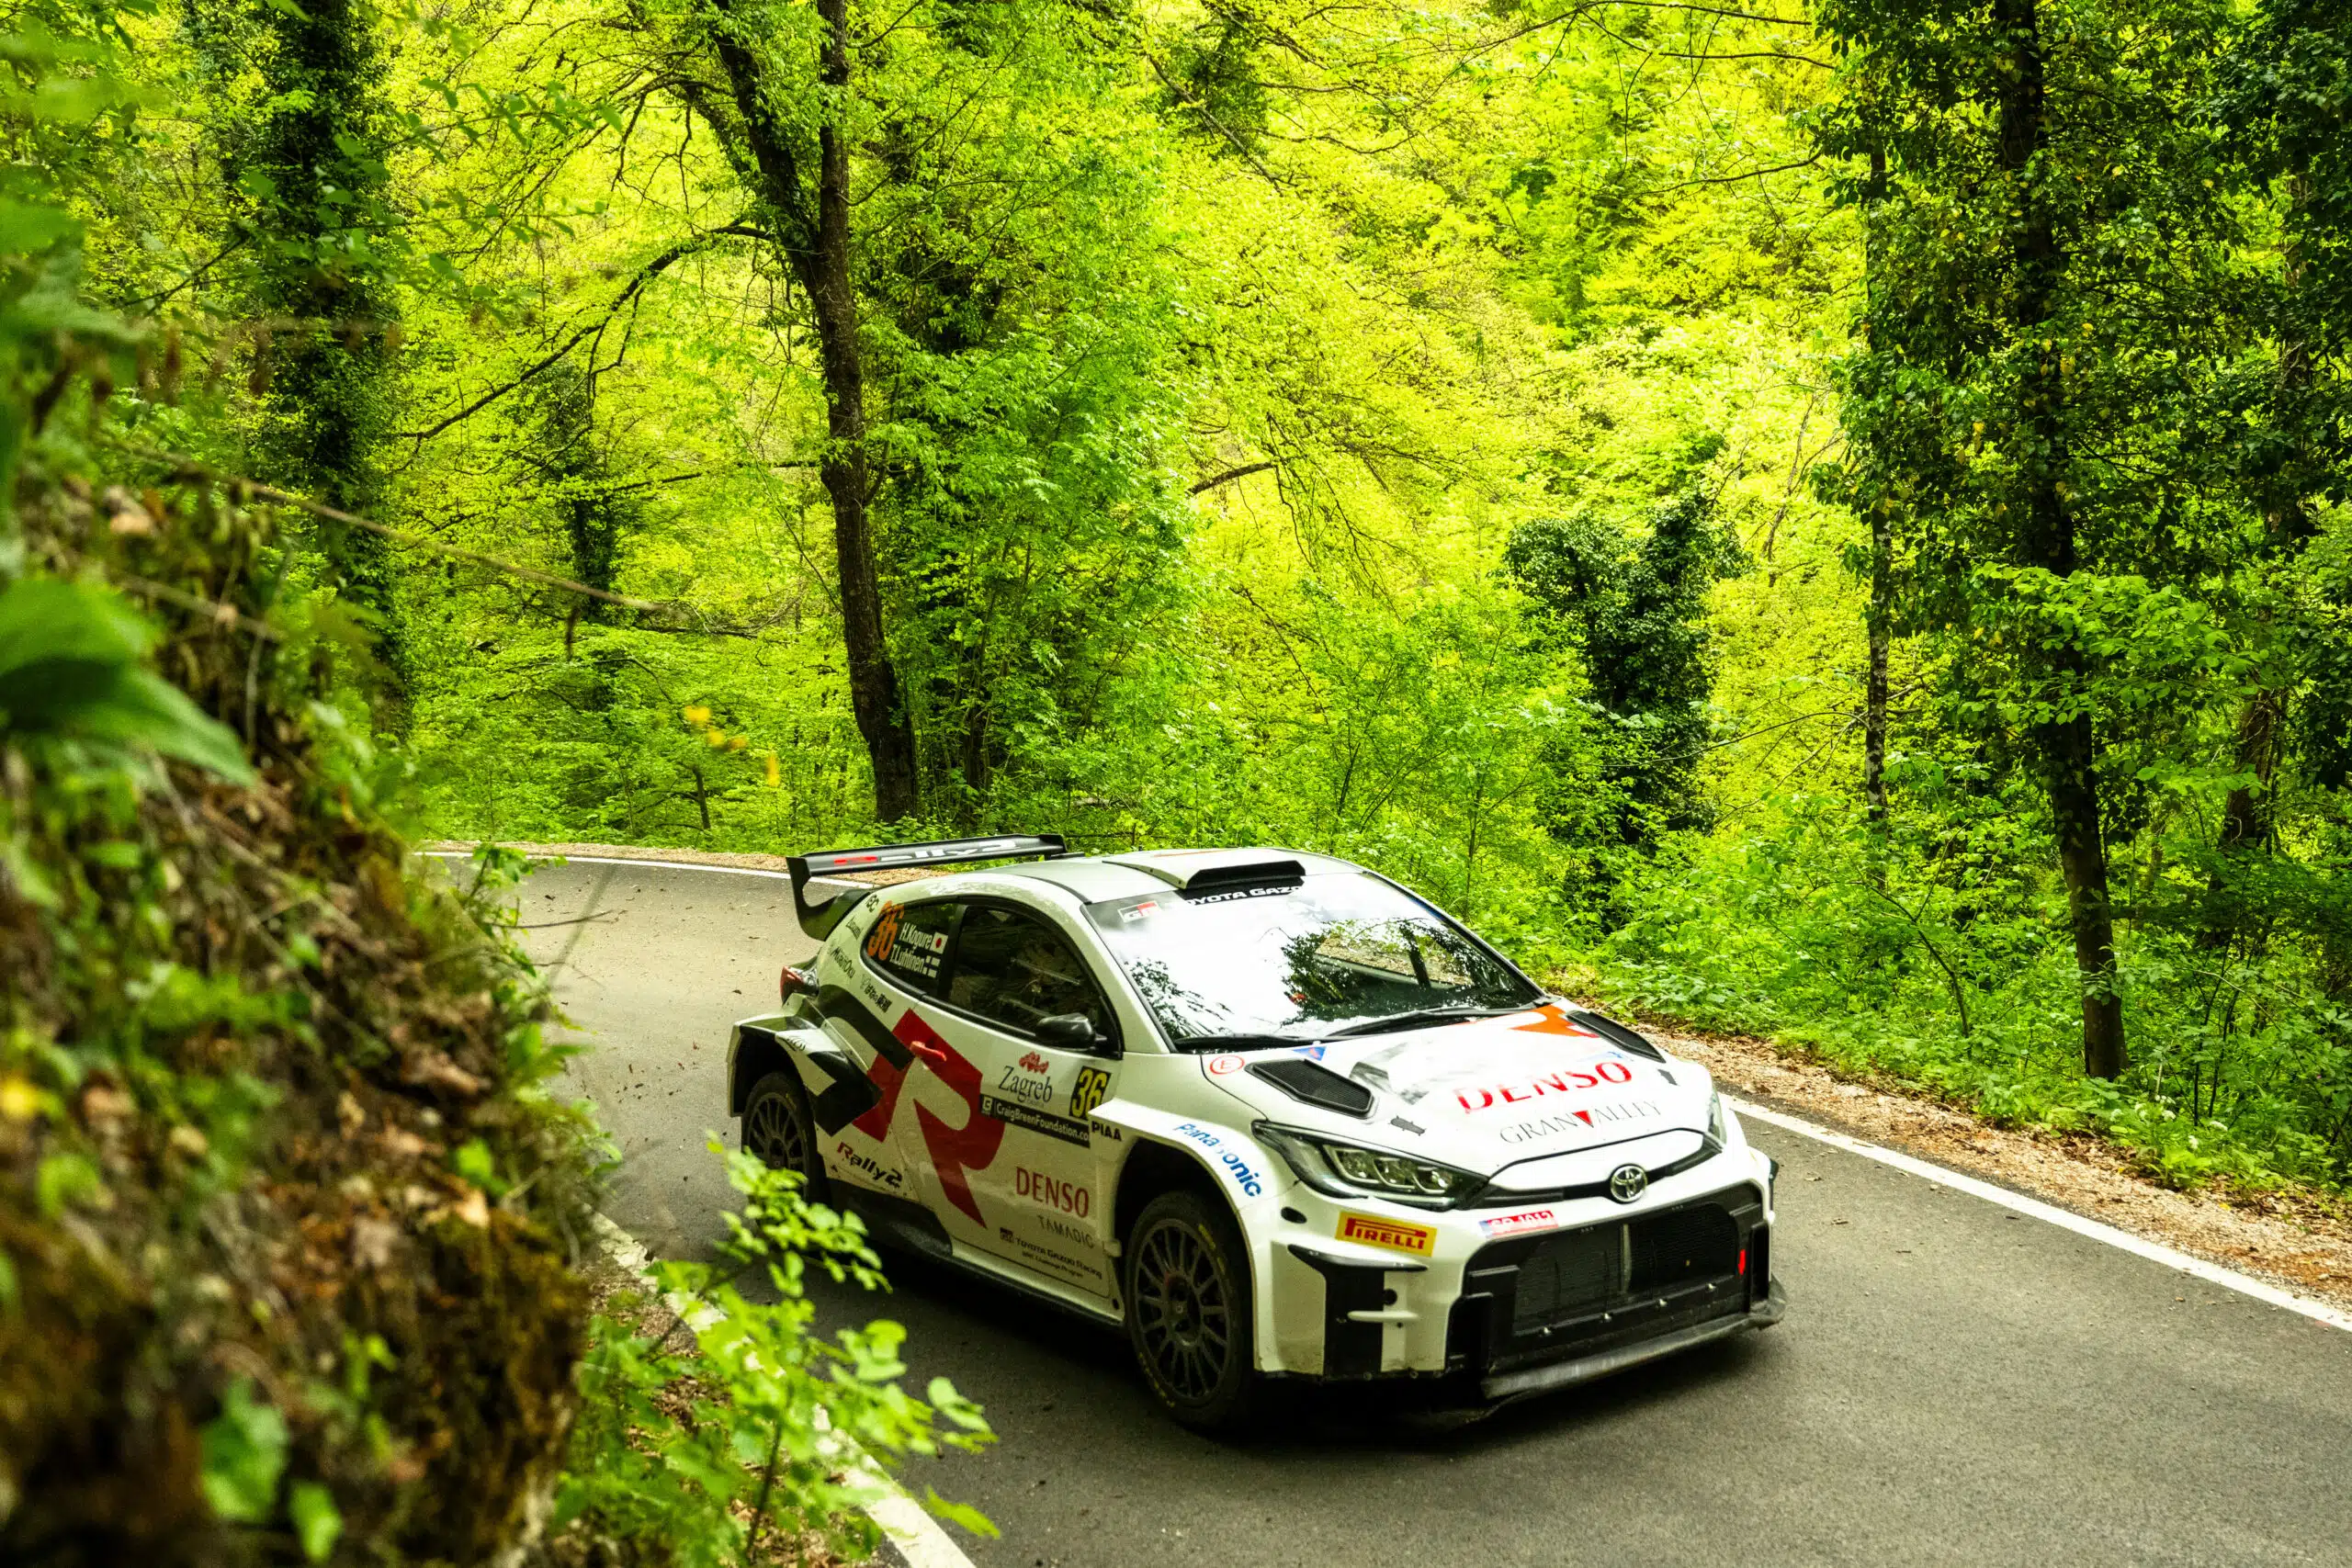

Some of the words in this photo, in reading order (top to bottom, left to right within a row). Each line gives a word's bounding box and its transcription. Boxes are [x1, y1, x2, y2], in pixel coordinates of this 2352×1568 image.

[1188, 889, 1247, 906] OYOTA
[866, 899, 905, 961] 36
[998, 1065, 1053, 1103] Zagreb
[1071, 1068, 1108, 1118] 36
[1453, 1062, 1632, 1114] DENSO
[996, 1102, 1089, 1142] CraigBreenFoundation.co
[1091, 1121, 1123, 1142] PIAA
[837, 1141, 903, 1189] Rally2
[1016, 1166, 1090, 1219] DENSO
[1037, 1214, 1094, 1249] TAMADIC
[1345, 1218, 1428, 1250] PIRELLI
